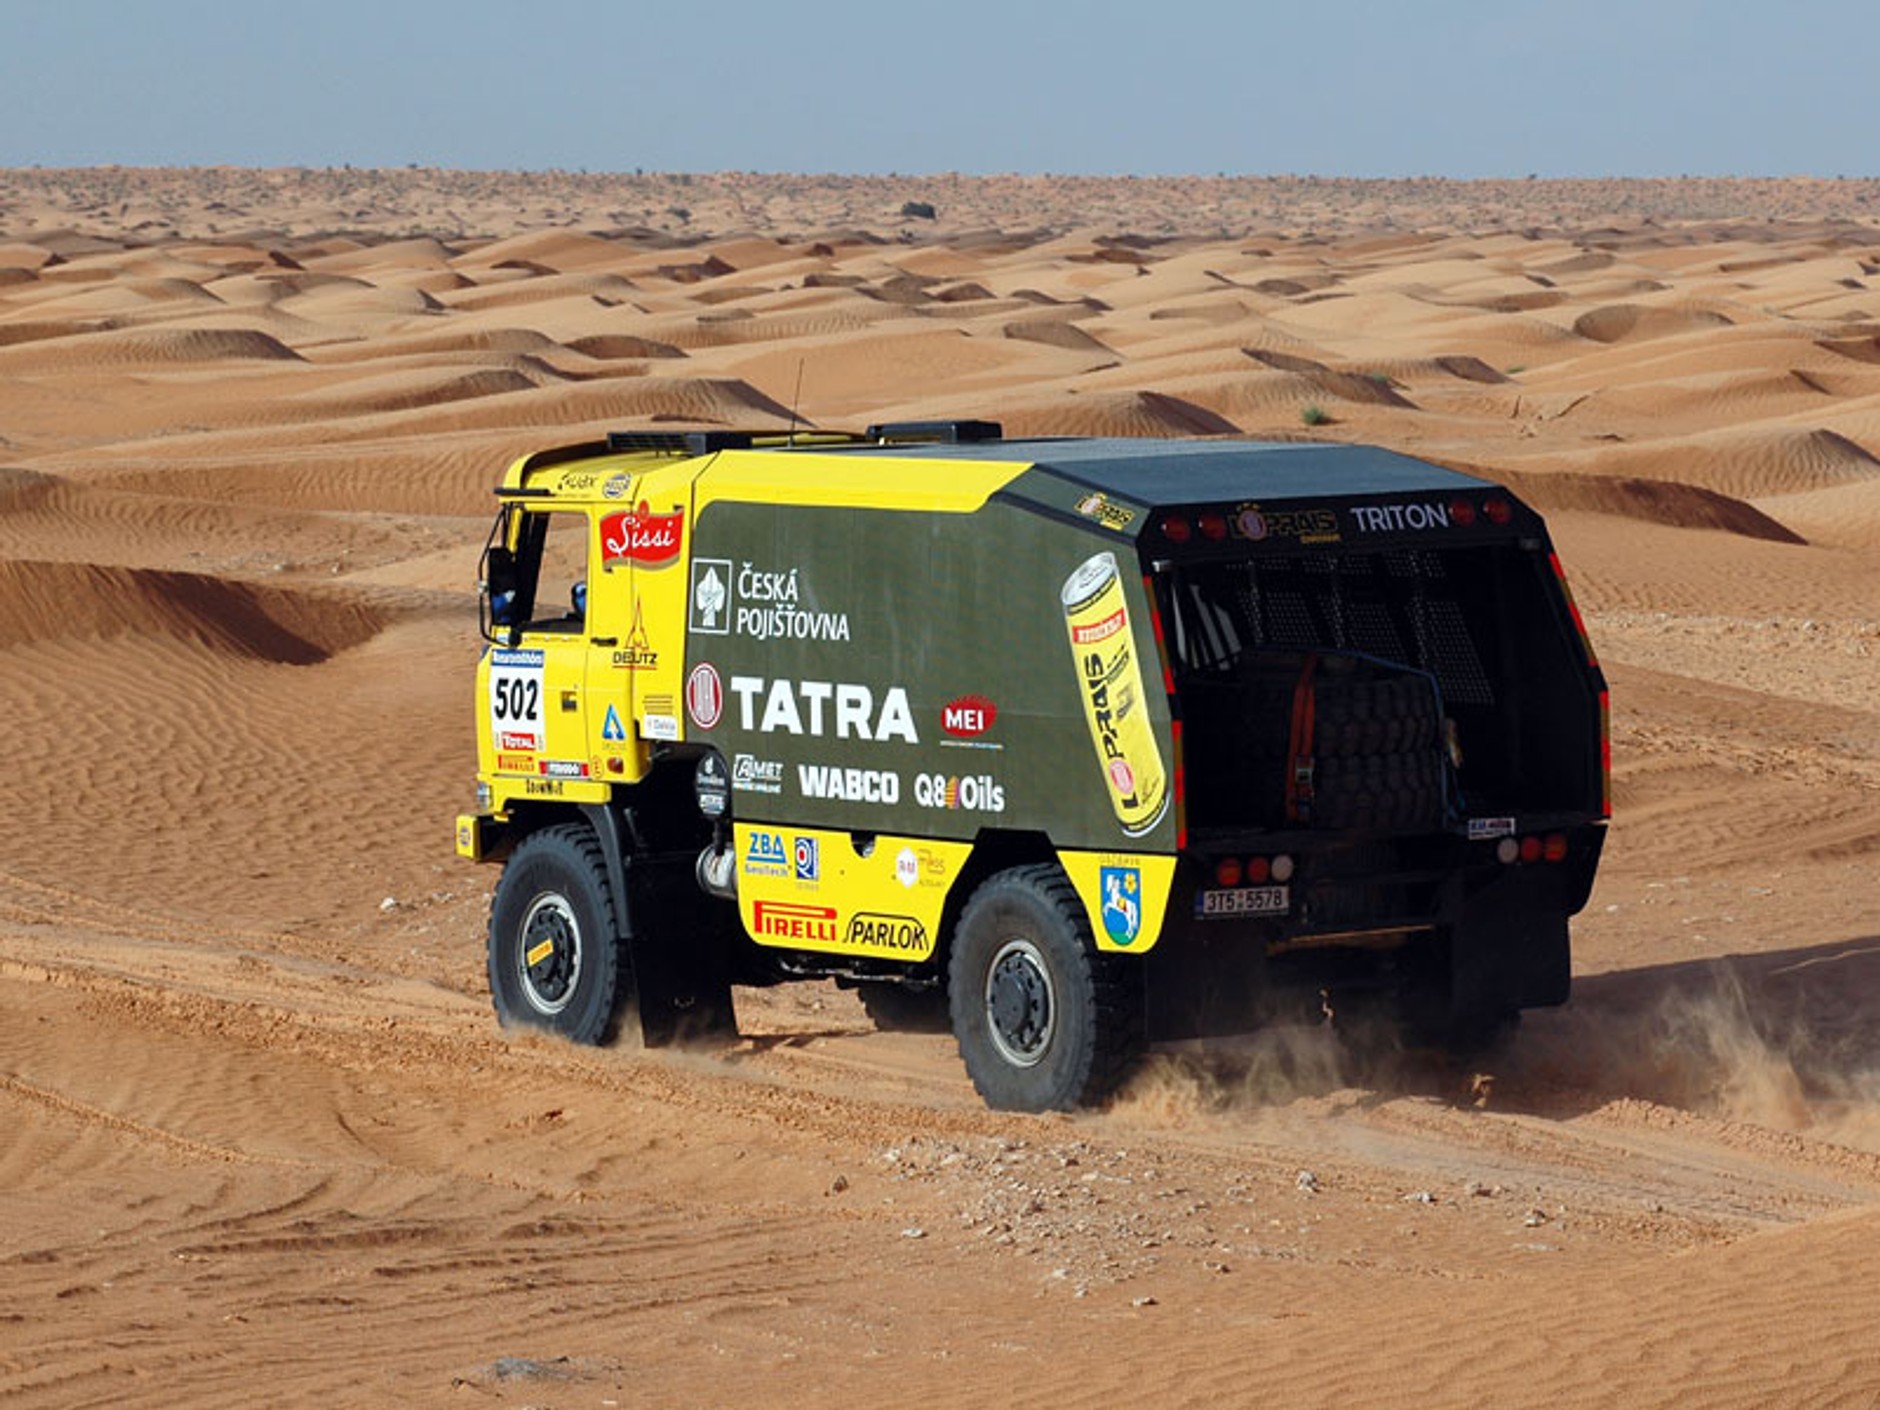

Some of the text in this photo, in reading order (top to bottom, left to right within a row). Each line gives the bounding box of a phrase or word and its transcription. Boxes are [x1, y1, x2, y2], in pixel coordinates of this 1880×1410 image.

[1350, 502, 1449, 532] TRITON
[606, 516, 675, 558] Sissi
[737, 561, 798, 601] ČESKÁ
[737, 602, 850, 641] POJIŠŤOVNA
[613, 651, 657, 664] DEUTZ
[494, 678, 538, 720] 502
[731, 676, 919, 744] TATRA
[945, 708, 984, 730] MEI
[798, 764, 1005, 812] WABCO Q8 Oils
[749, 832, 785, 856] ZBA
[753, 900, 838, 941] PIRELLI
[1207, 892, 1235, 911] 3T5
[850, 920, 925, 951] PARLOK
